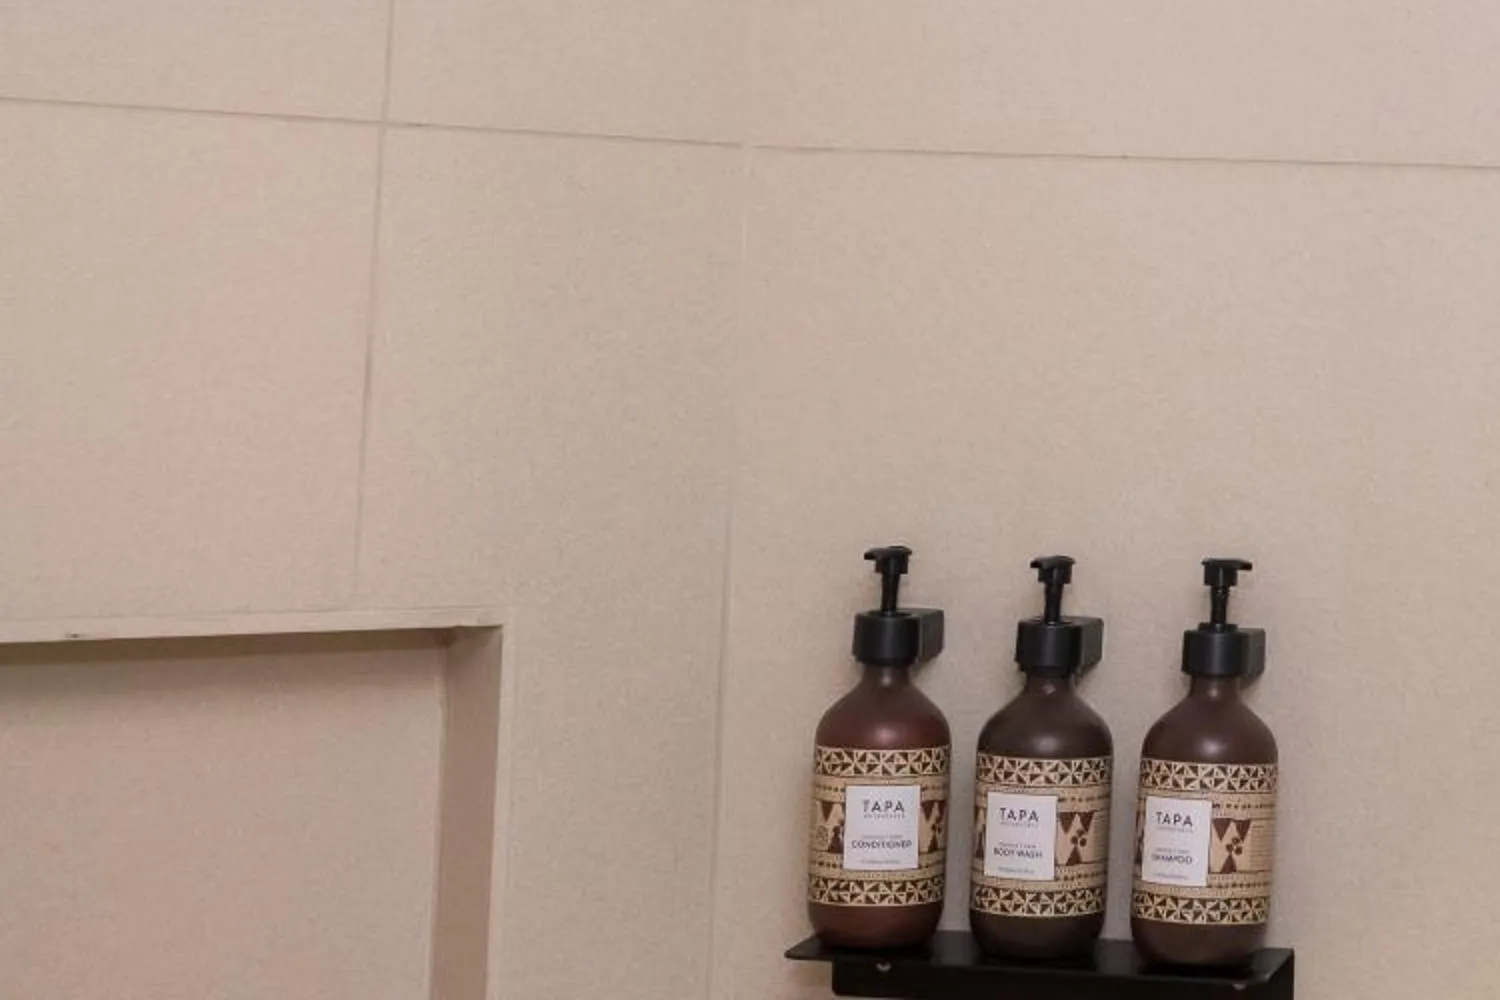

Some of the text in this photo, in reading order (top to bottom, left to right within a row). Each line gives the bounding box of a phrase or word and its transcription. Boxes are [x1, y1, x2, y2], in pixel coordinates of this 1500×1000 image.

[863, 799, 905, 813] TAPA
[999, 807, 1039, 823] TAPA
[1155, 811, 1193, 827] TAPA
